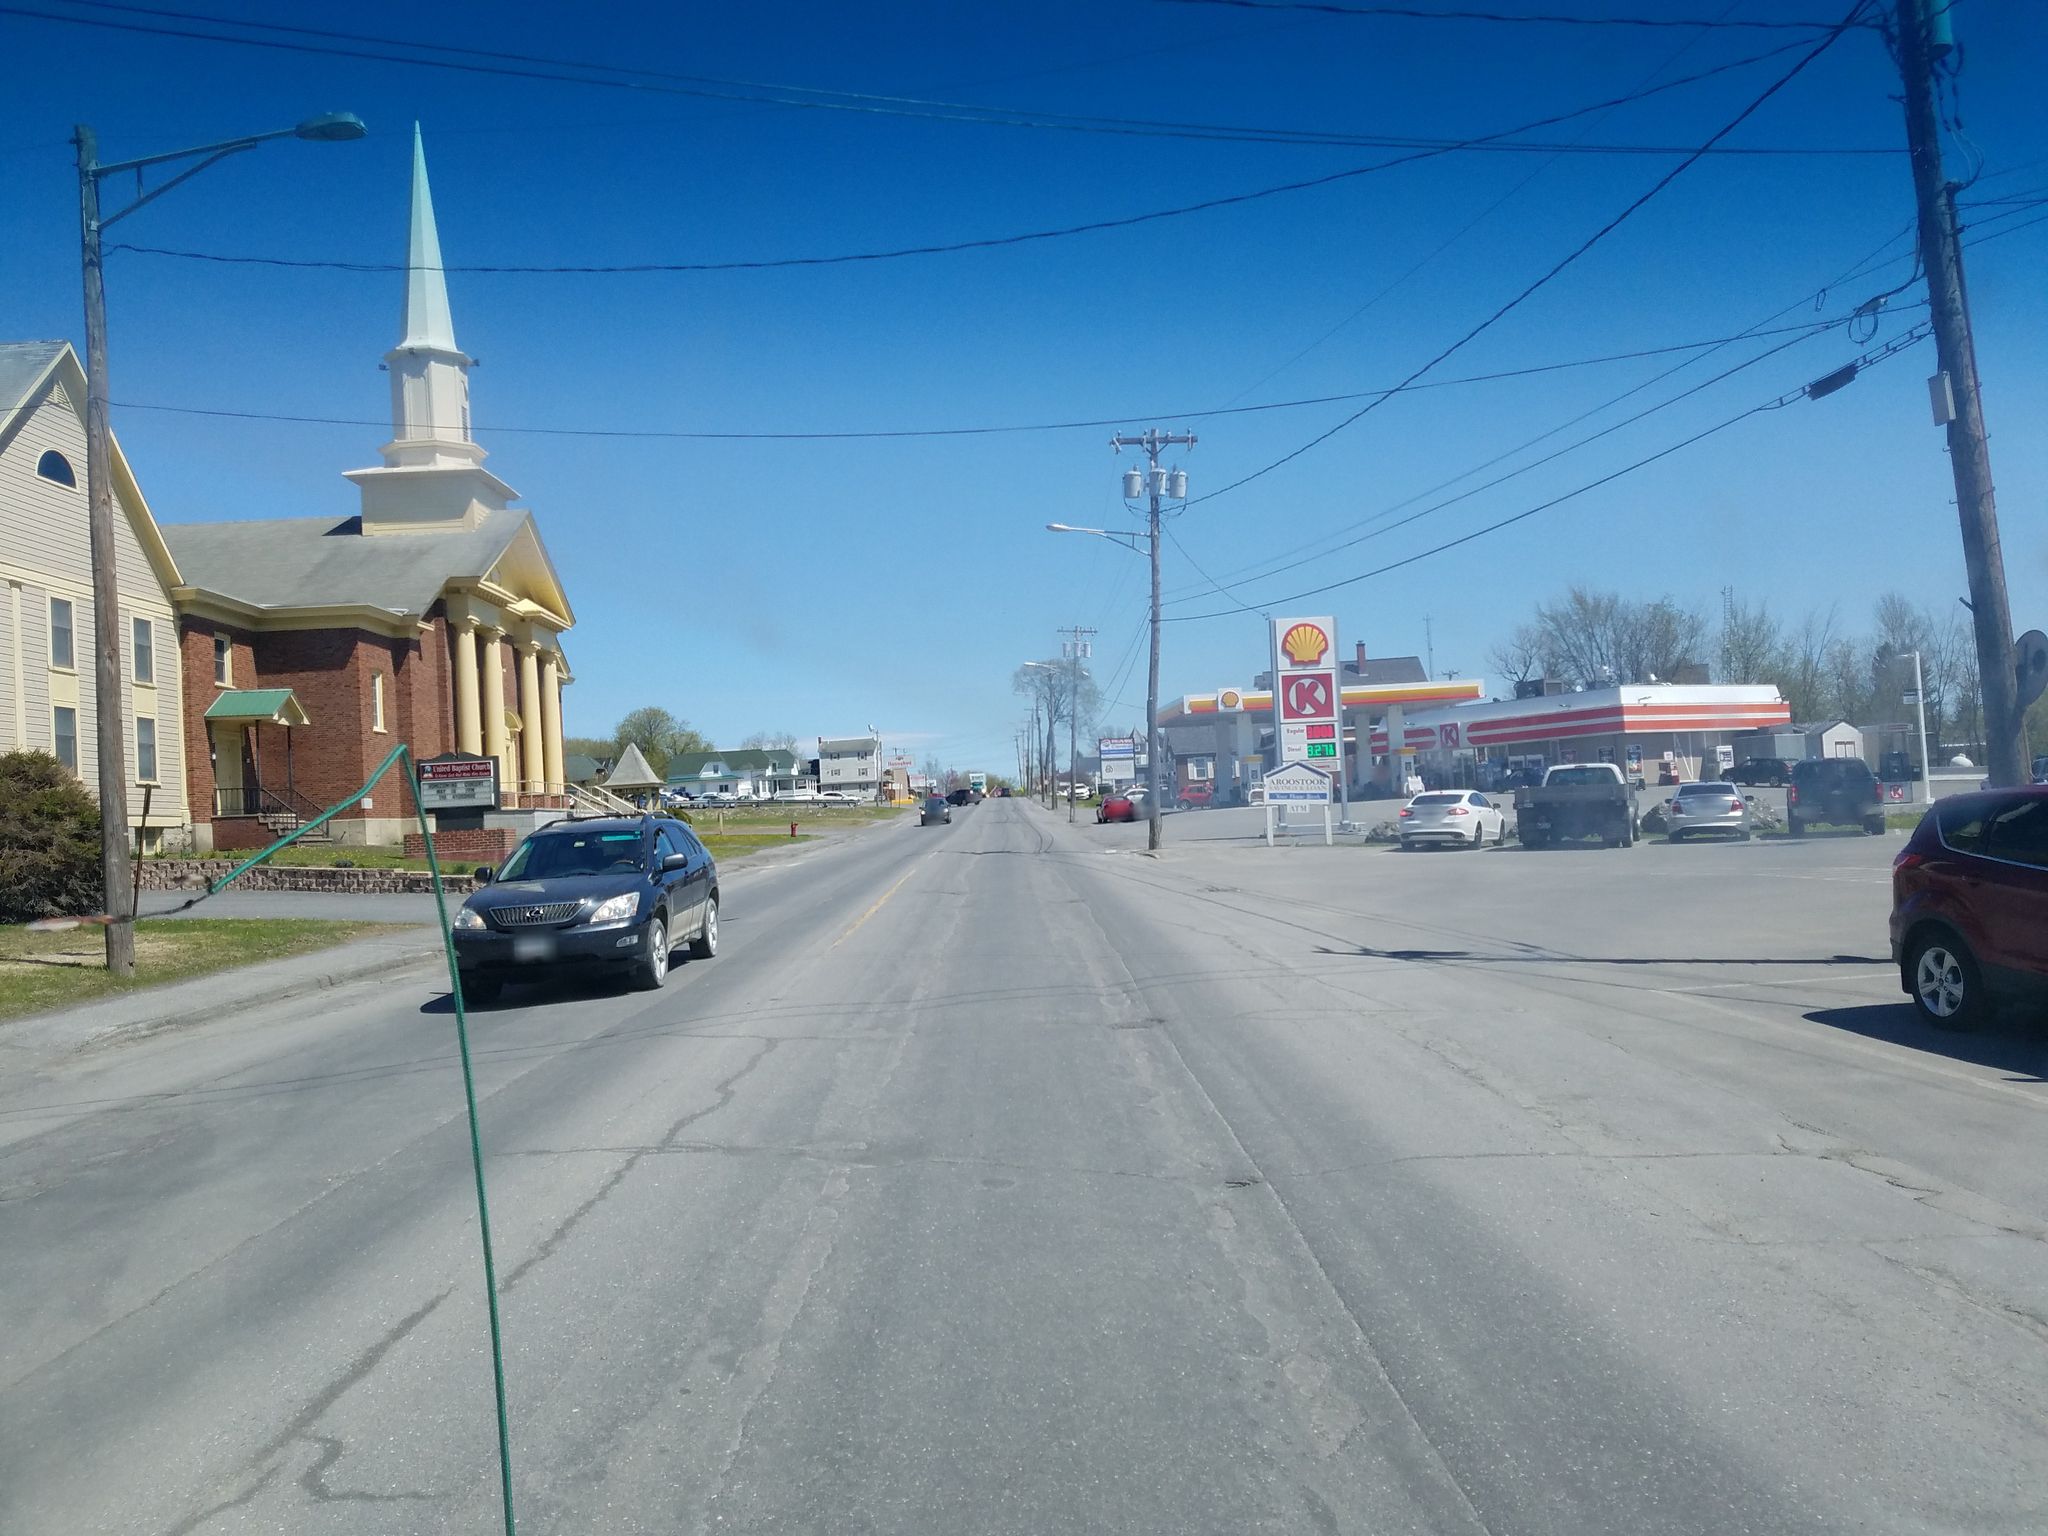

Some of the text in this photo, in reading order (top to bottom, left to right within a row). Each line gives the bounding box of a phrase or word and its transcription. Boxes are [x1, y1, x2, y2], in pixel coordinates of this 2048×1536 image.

[1292, 679, 1325, 714] K
[1442, 726, 1458, 747] K
[452, 764, 470, 772] Baptist
[472, 763, 491, 771] Church
[1271, 778, 1327, 786] AROOSTOOK
[1290, 804, 1307, 812] ATM
